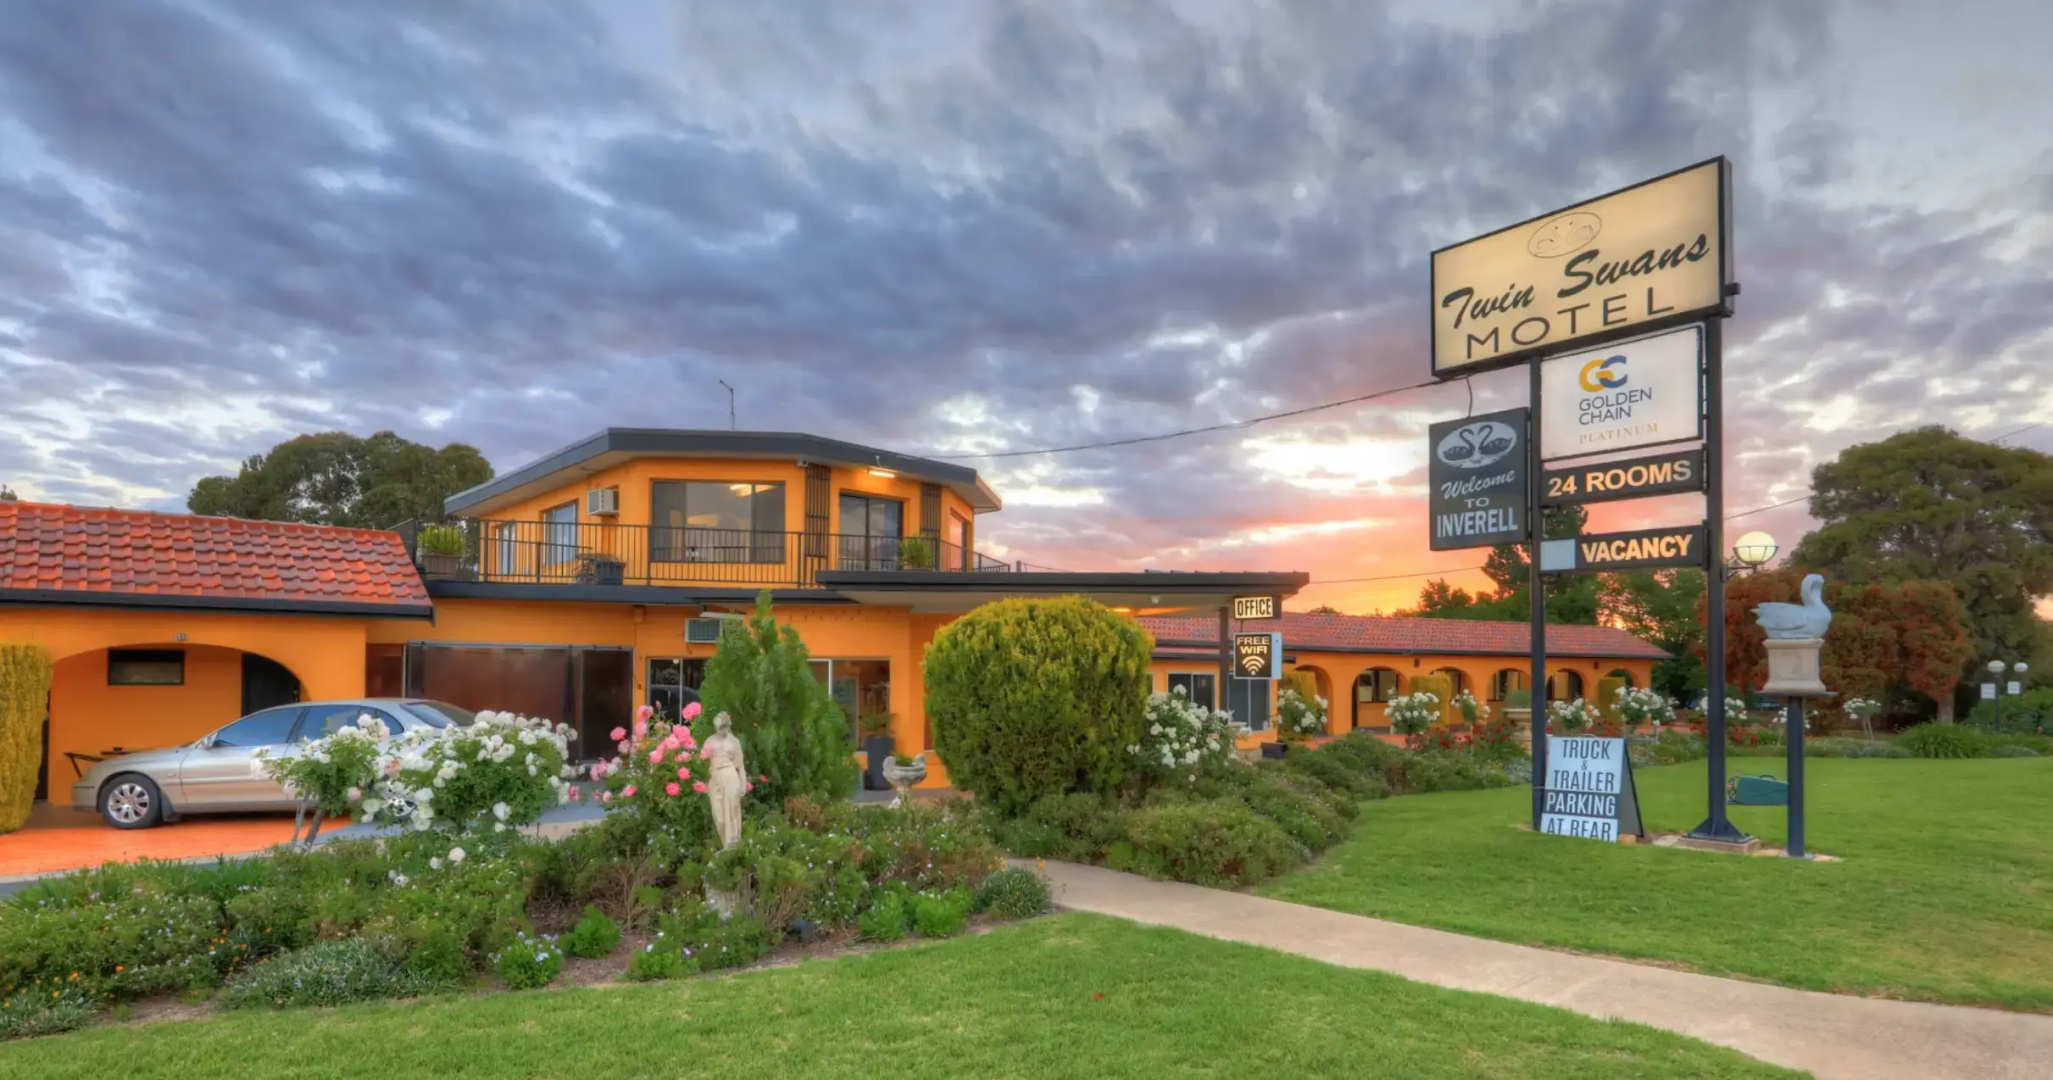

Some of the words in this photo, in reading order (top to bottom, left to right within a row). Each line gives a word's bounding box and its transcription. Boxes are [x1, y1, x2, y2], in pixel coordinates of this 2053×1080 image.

[1442, 283, 1536, 329] Twin
[1556, 233, 1710, 298] Swans
[1466, 286, 1674, 359] MOTEL
[1579, 387, 1652, 411] GOLDEN
[1579, 405, 1632, 425] CHAIN
[1580, 423, 1658, 444] PLATINUM
[1440, 470, 1515, 500] Welcome
[1548, 475, 1577, 498] 24
[1585, 459, 1693, 493] ROOMS
[1464, 497, 1490, 508] TO
[1436, 507, 1519, 538] INVERELL
[1581, 534, 1693, 563] VACANCY
[1237, 599, 1271, 616] OFFICE
[1237, 637, 1270, 645] FREE
[1562, 739, 1611, 760] TRUCK
[1581, 759, 1588, 771] &
[1553, 769, 1615, 792] TRAILER
[1546, 792, 1615, 816] PARKING
[1546, 817, 1564, 835] AT
[1569, 819, 1612, 841] REAR
